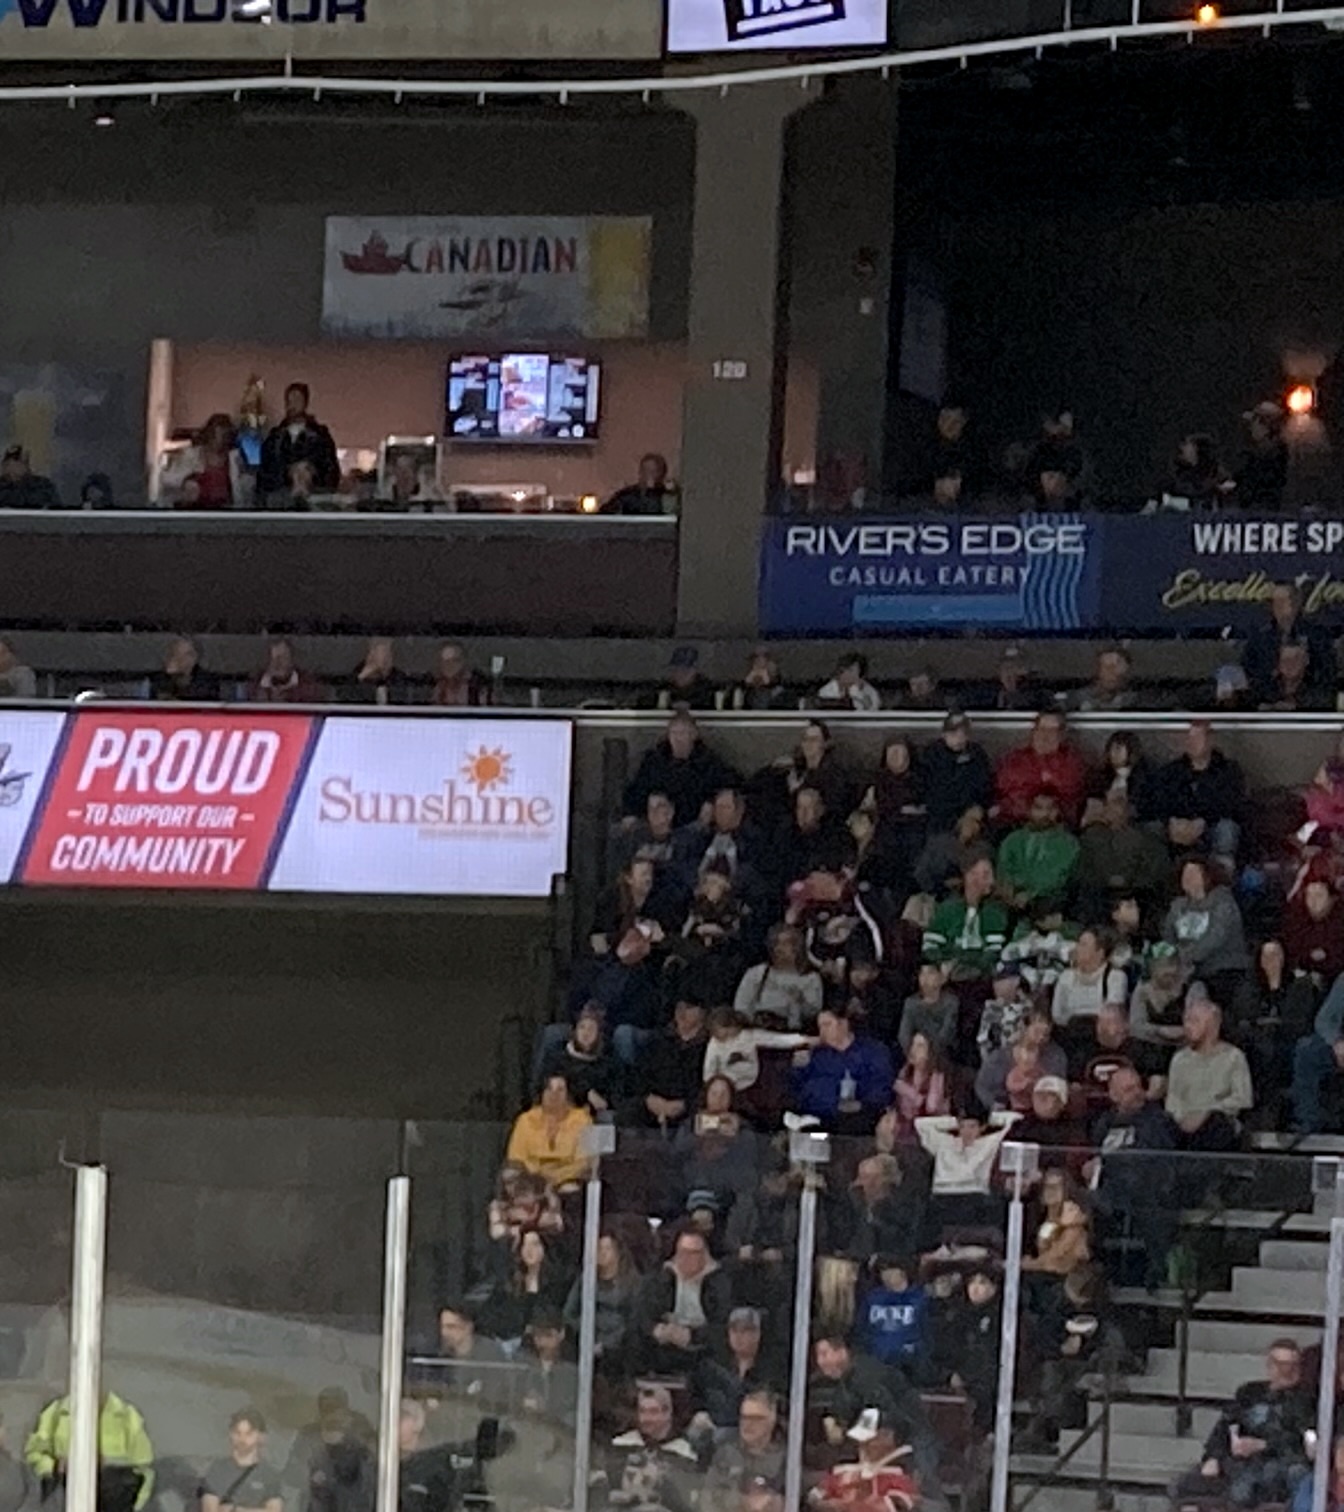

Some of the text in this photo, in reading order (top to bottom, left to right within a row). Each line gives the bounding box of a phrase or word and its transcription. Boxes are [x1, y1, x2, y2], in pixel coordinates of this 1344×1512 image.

[402, 235, 578, 275] CANADIAN
[786, 523, 1087, 557] RIVER'S EDGE
[1193, 522, 1344, 554] WHERE SP
[829, 565, 1031, 587] CASUAL EATERY
[1162, 568, 1310, 609] Excelle
[76, 727, 281, 795] PROUD
[83, 803, 239, 829] TO SUPPORT OUR
[318, 775, 555, 827] Sunshine
[49, 833, 247, 875] COMMUNITY
